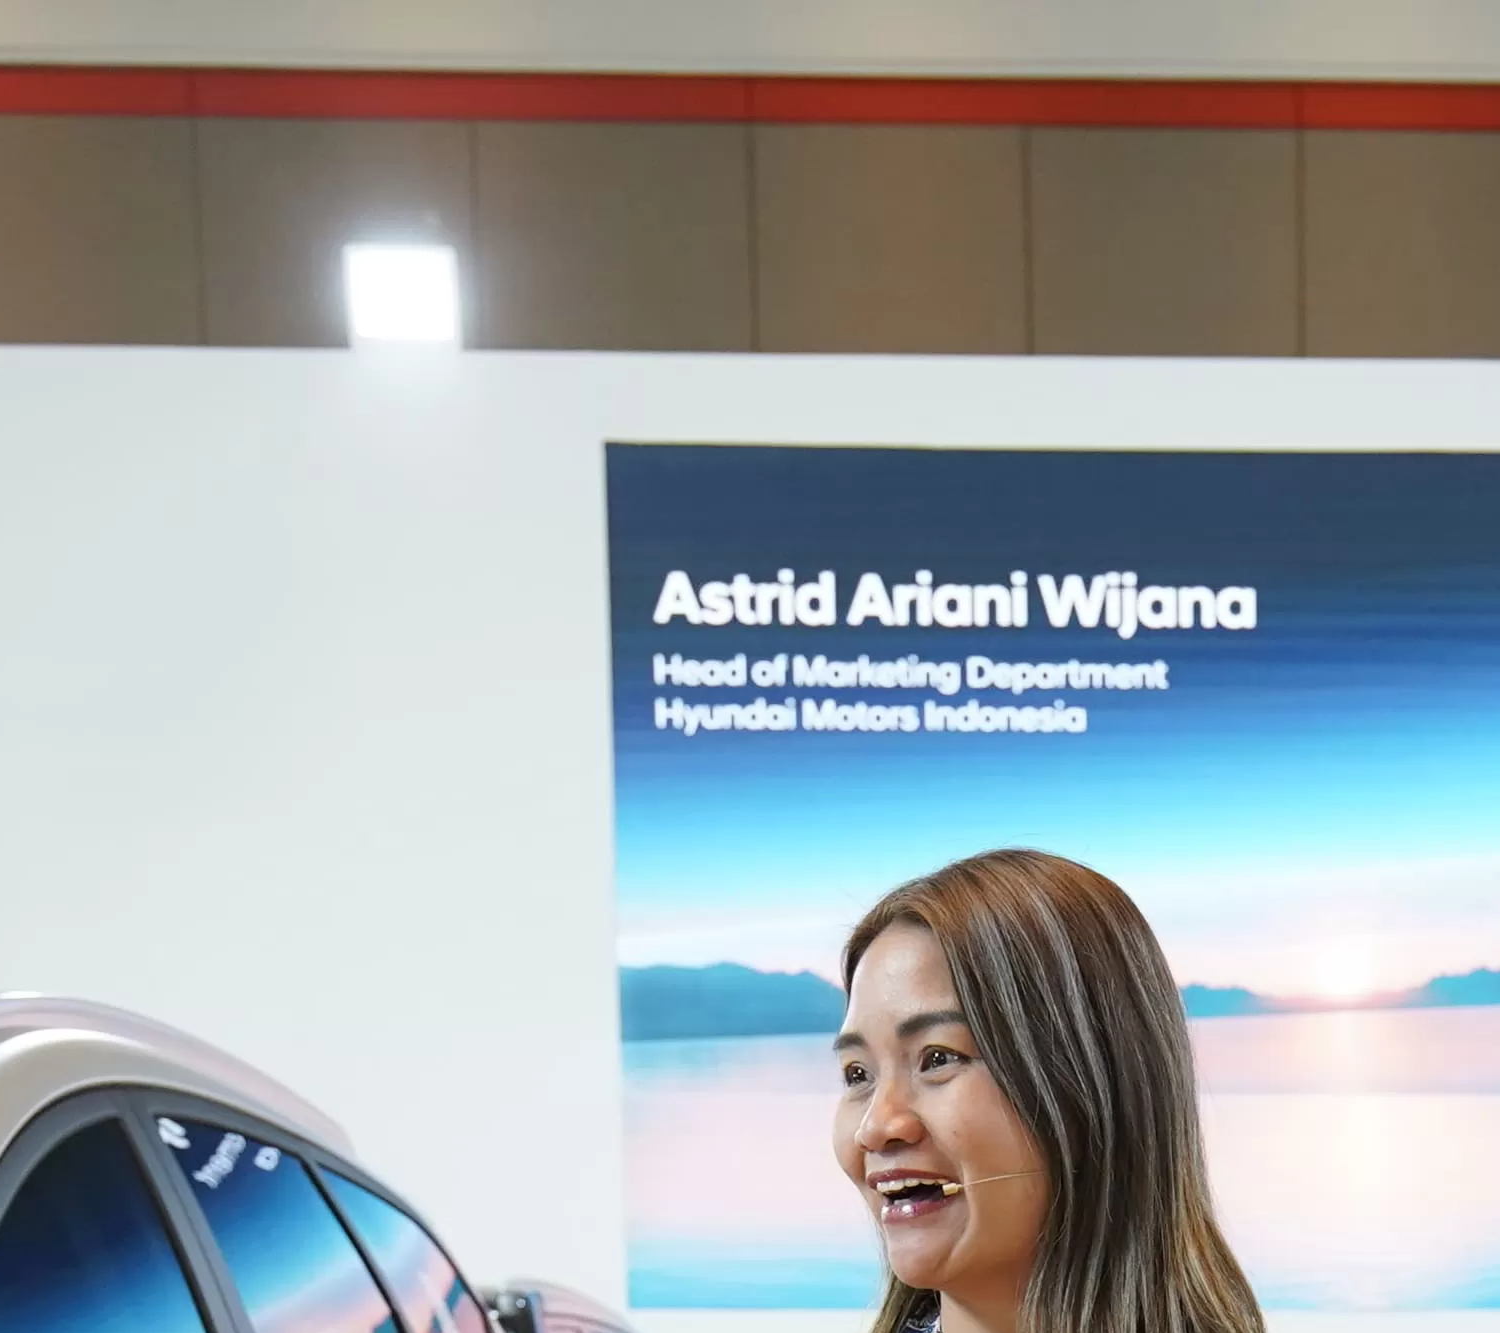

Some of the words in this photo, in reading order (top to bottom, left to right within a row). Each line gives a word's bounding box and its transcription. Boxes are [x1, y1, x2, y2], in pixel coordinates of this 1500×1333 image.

[653, 569, 836, 626] Astrid
[846, 570, 1028, 627] Ariani
[1038, 571, 1257, 639] Wijana
[653, 653, 748, 687] Head
[750, 653, 789, 688] of
[793, 654, 961, 695] Marketing
[965, 656, 1170, 694] Department
[654, 697, 797, 736] Hyundai
[802, 700, 920, 732] Motors
[924, 699, 1088, 733] Indonesia
